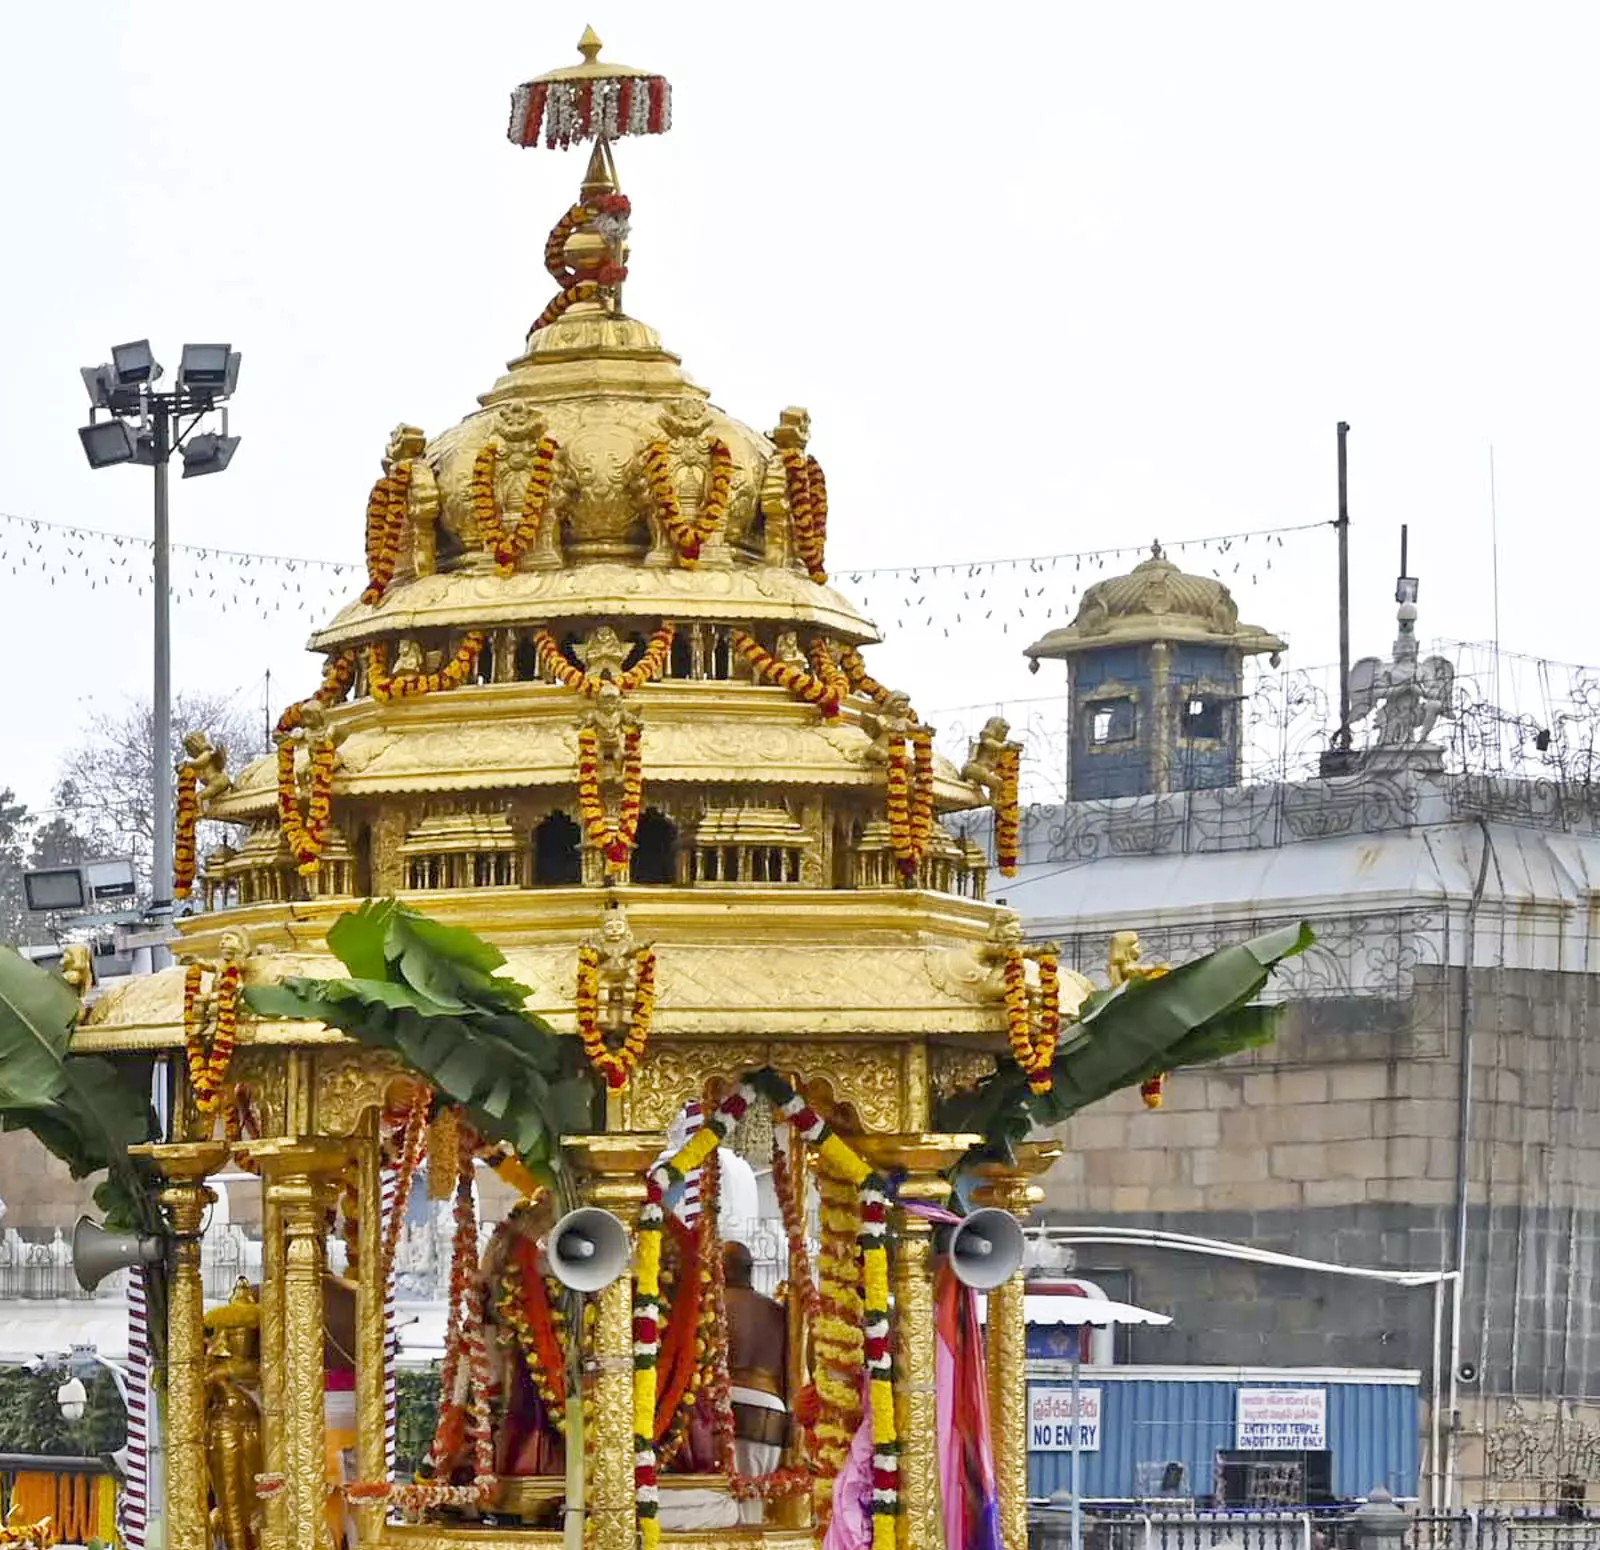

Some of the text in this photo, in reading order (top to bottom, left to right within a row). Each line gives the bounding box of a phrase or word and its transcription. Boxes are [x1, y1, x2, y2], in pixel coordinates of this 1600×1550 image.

[1244, 1423, 1320, 1434] ENTRY FOR TEMPLE
[1033, 1425, 1097, 1445] NO ENRY
[1277, 1436, 1300, 1447] STAFF
[1302, 1436, 1323, 1447] ONLY
